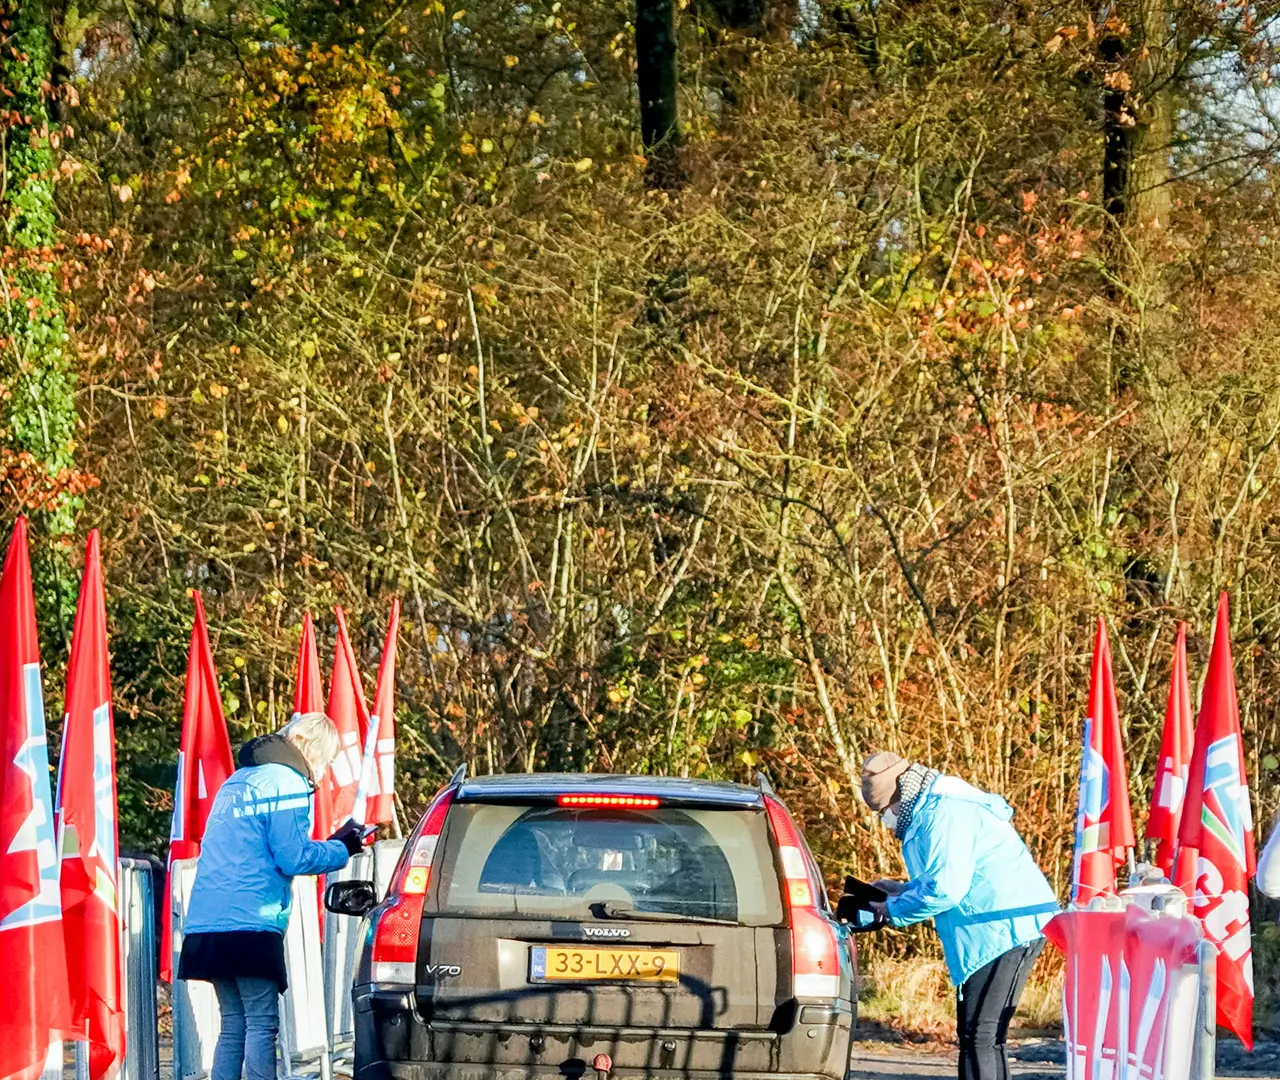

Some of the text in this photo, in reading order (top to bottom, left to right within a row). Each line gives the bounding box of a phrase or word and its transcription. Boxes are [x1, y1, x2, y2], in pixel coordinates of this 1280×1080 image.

[583, 927, 631, 937] VOLVO
[533, 965, 545, 973] NL
[555, 952, 666, 976] 33-LXX-9
[425, 964, 462, 975] V70
